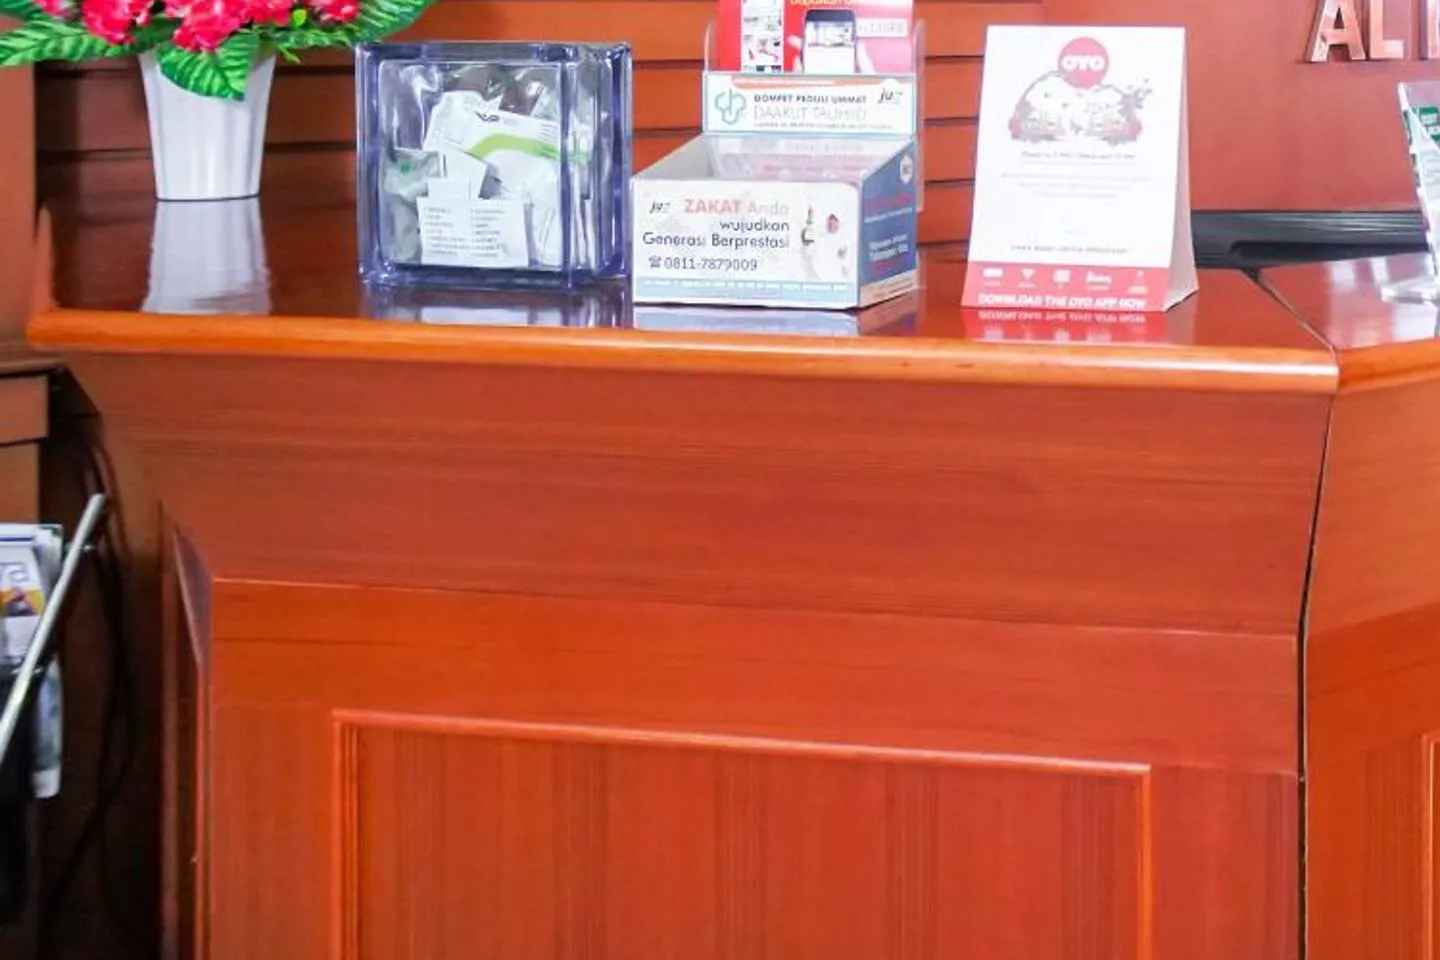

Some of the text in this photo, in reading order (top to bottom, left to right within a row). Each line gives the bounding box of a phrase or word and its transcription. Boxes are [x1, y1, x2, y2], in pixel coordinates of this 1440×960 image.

[1061, 54, 1106, 72] OYO
[684, 199, 790, 217] ZAKAT Anda
[719, 219, 790, 235] wujudkan
[642, 231, 790, 250] Generasi Berprestasi
